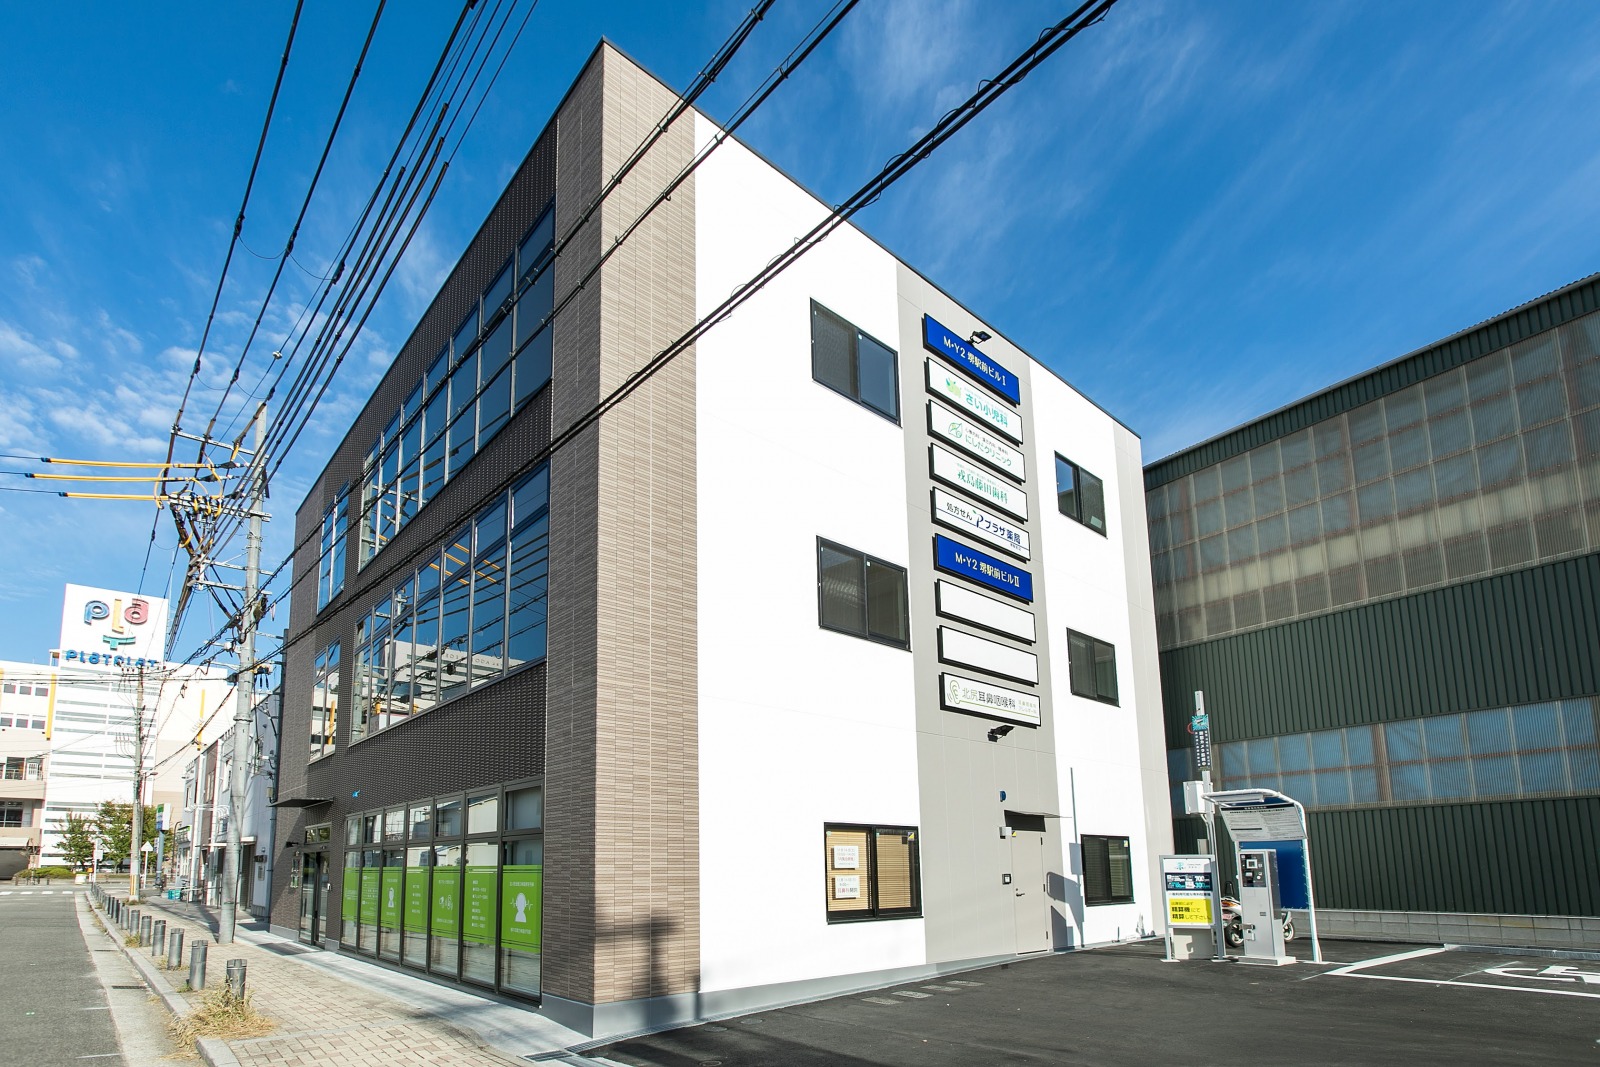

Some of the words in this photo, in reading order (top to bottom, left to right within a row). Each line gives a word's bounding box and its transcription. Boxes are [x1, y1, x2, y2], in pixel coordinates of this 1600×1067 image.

[965, 393, 1008, 427] さい小児科
[965, 434, 1012, 466] にしだクリニック
[946, 502, 973, 521] 処方せん
